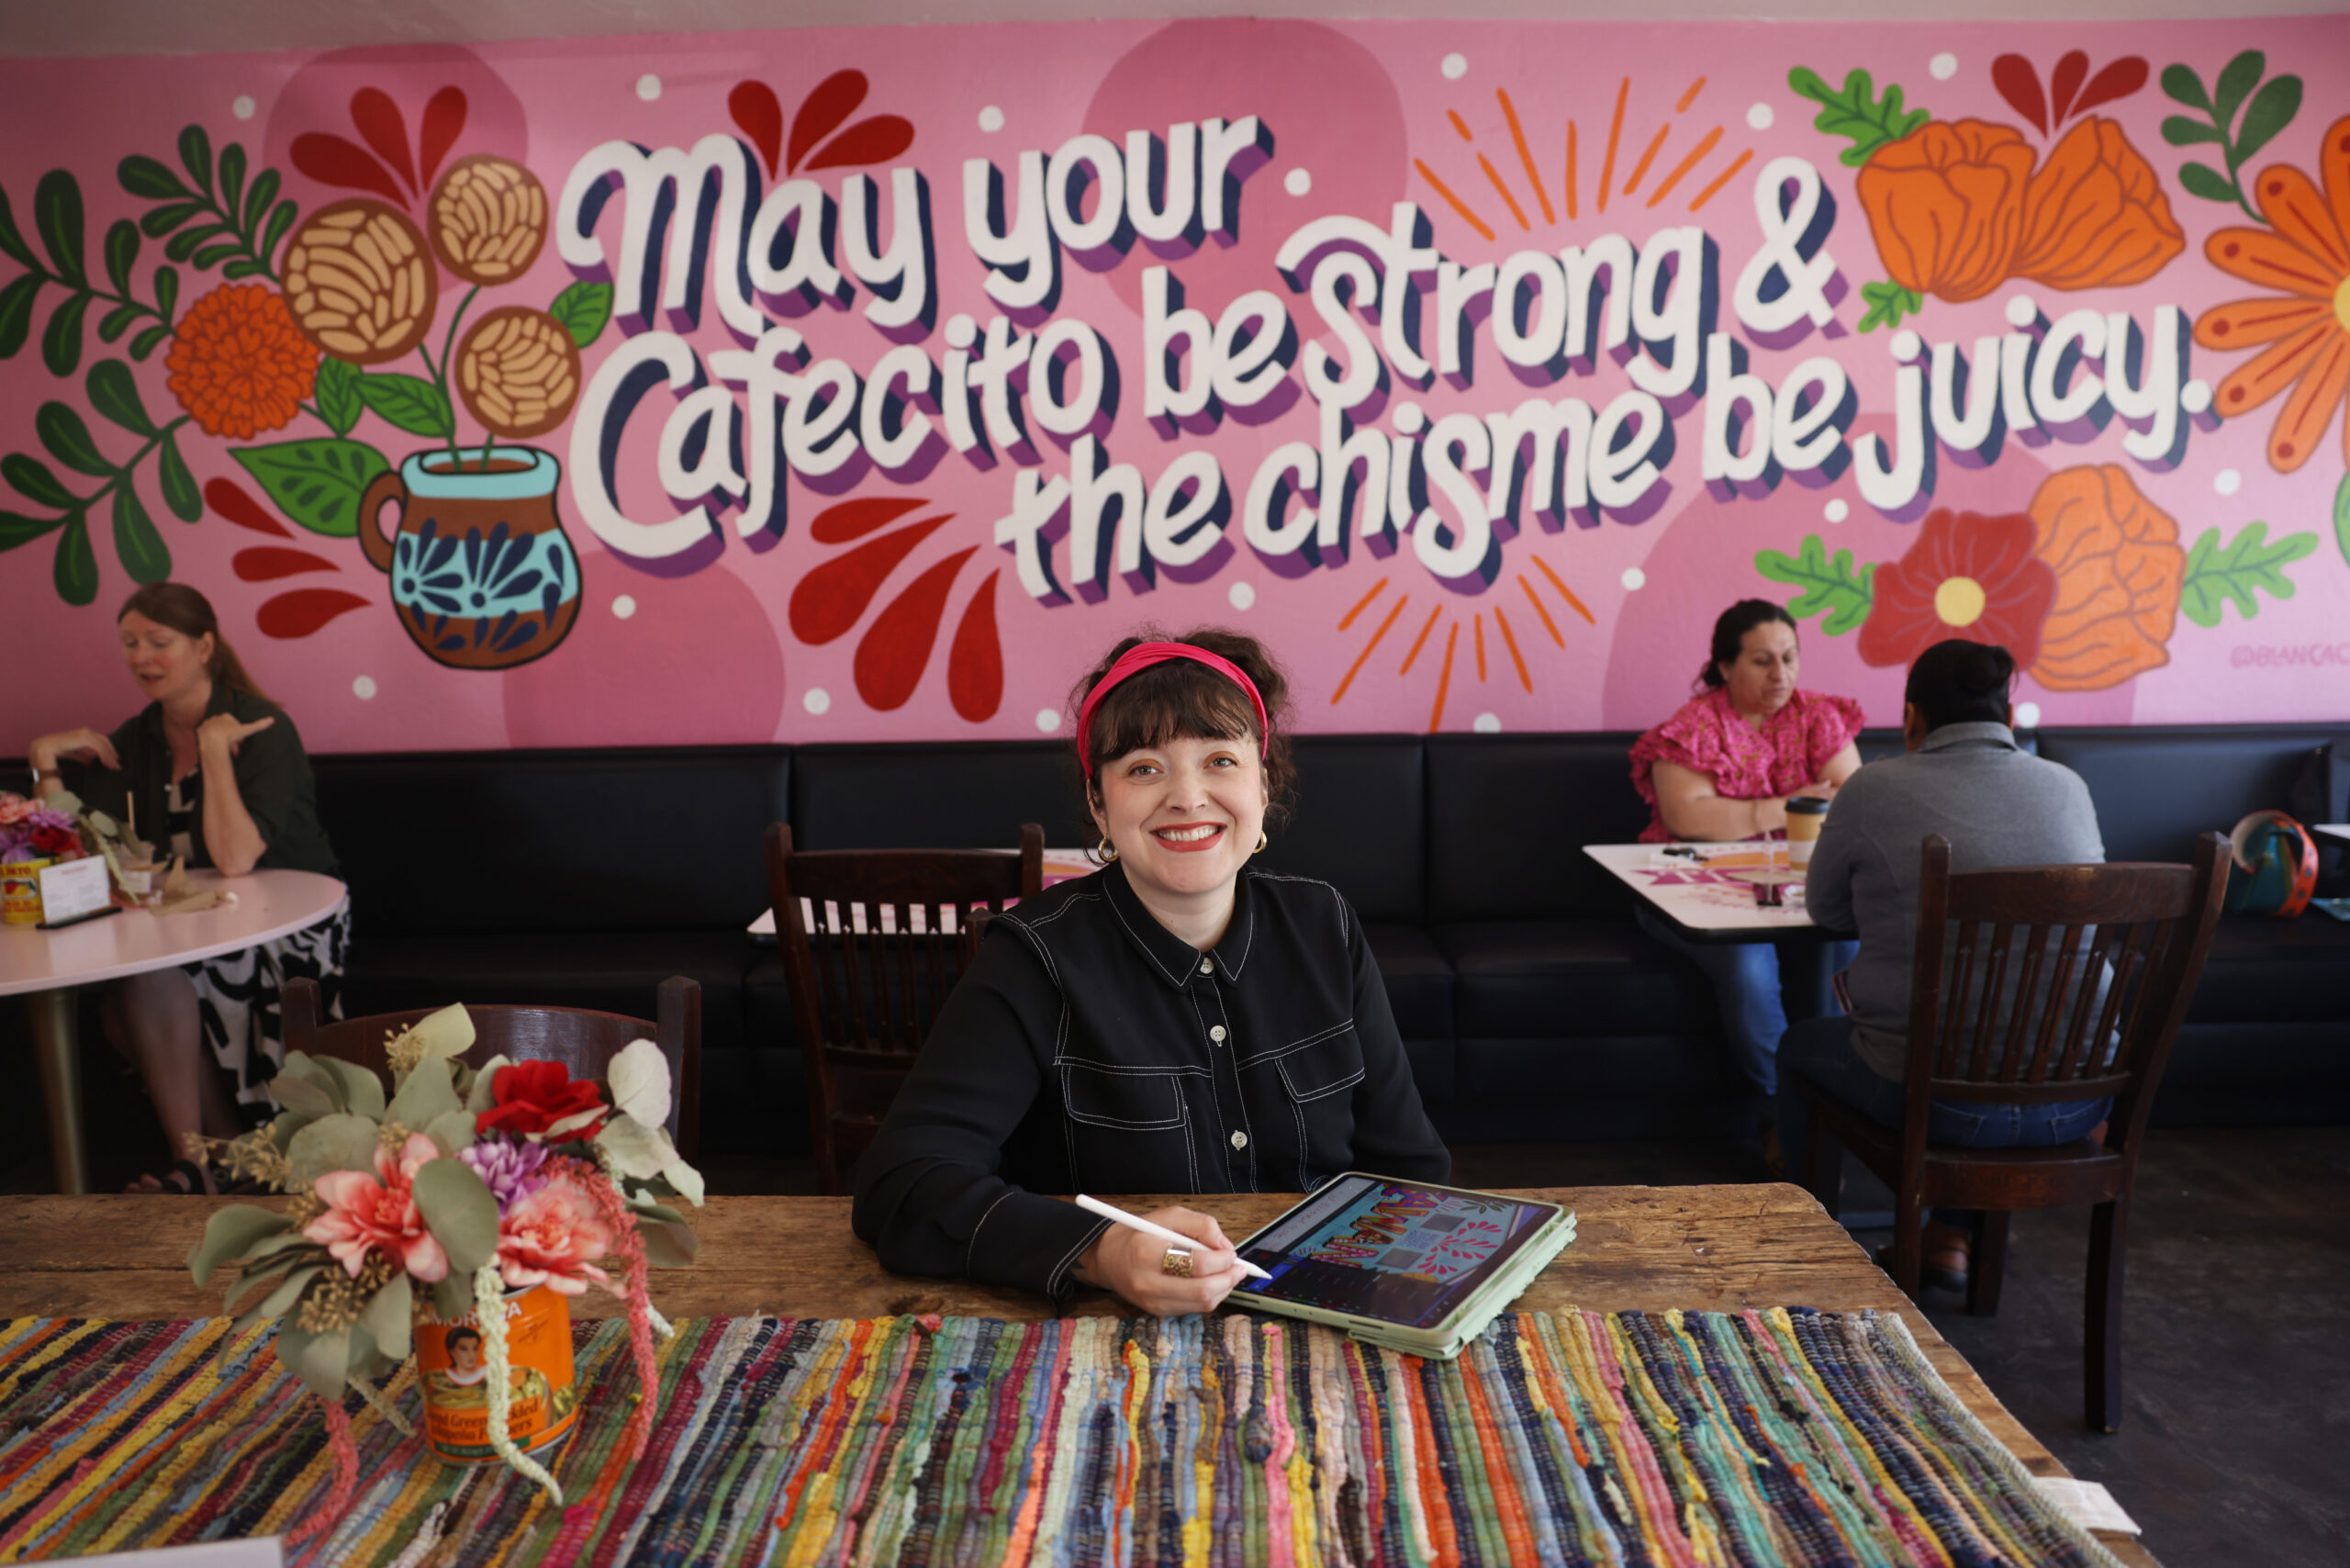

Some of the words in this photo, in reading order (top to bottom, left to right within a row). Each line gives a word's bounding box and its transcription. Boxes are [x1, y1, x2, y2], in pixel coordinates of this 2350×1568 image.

[554, 134, 930, 338] May
[963, 115, 1260, 310] your
[568, 313, 1105, 560] Cafecito
[1141, 266, 1289, 419] be
[1733, 156, 1840, 333] &
[994, 432, 1225, 599] the
[1243, 391, 1666, 578] chisme
[1702, 332, 1848, 484] be
[1853, 295, 2213, 511] juicy.
